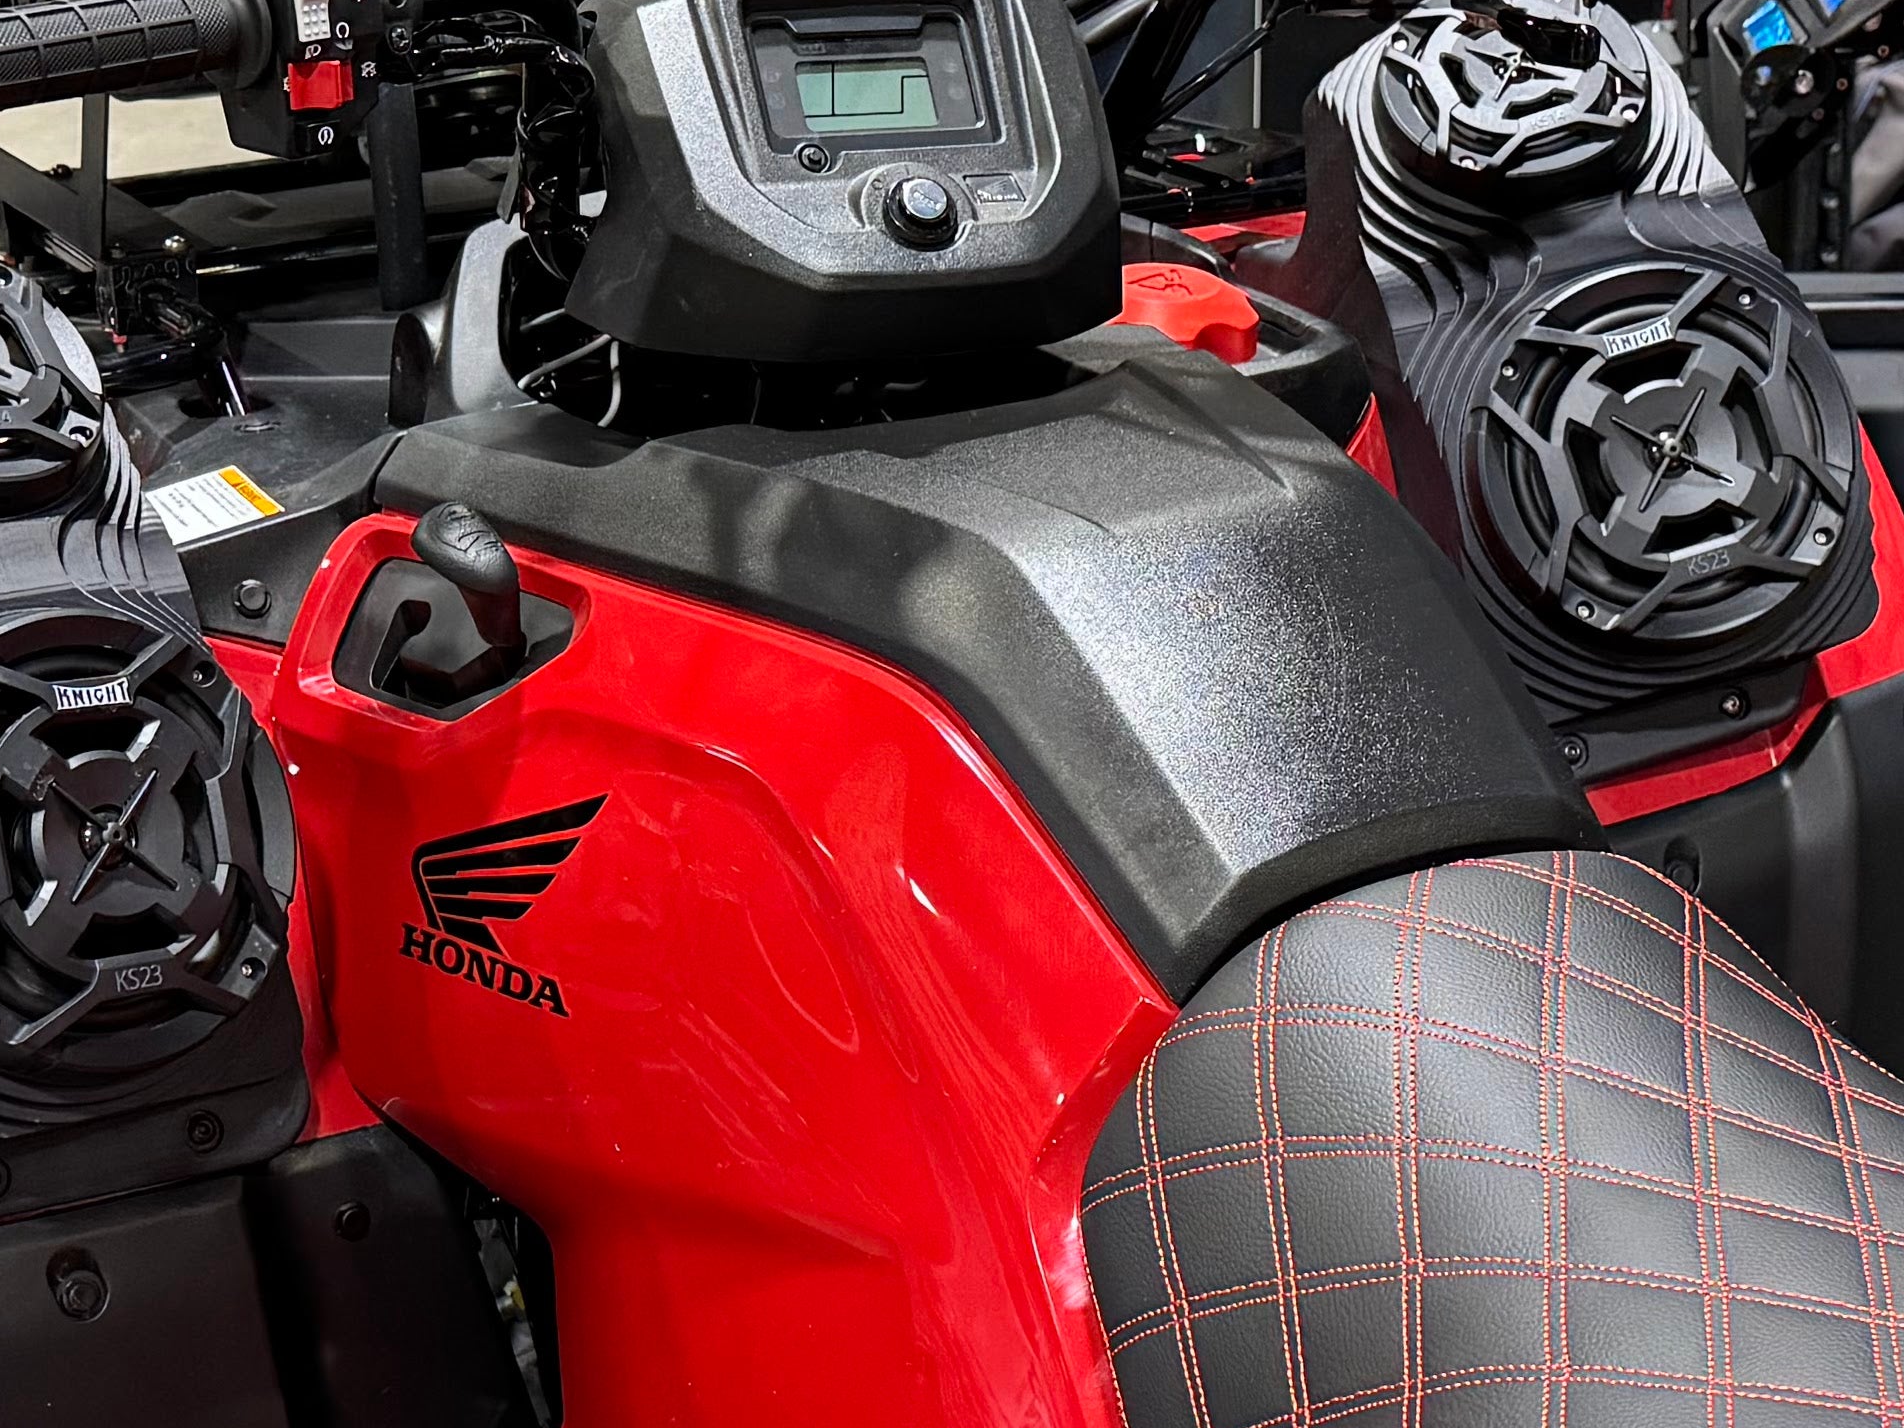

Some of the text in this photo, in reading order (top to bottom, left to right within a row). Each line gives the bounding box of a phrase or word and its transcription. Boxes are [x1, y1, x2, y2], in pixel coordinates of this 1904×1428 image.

[1606, 320, 1670, 354] KNIGHT
[1687, 548, 1731, 577] KS23
[57, 679, 127, 708] KNIGHT
[114, 963, 163, 992] KS23
[399, 922, 572, 1020] HONDA
